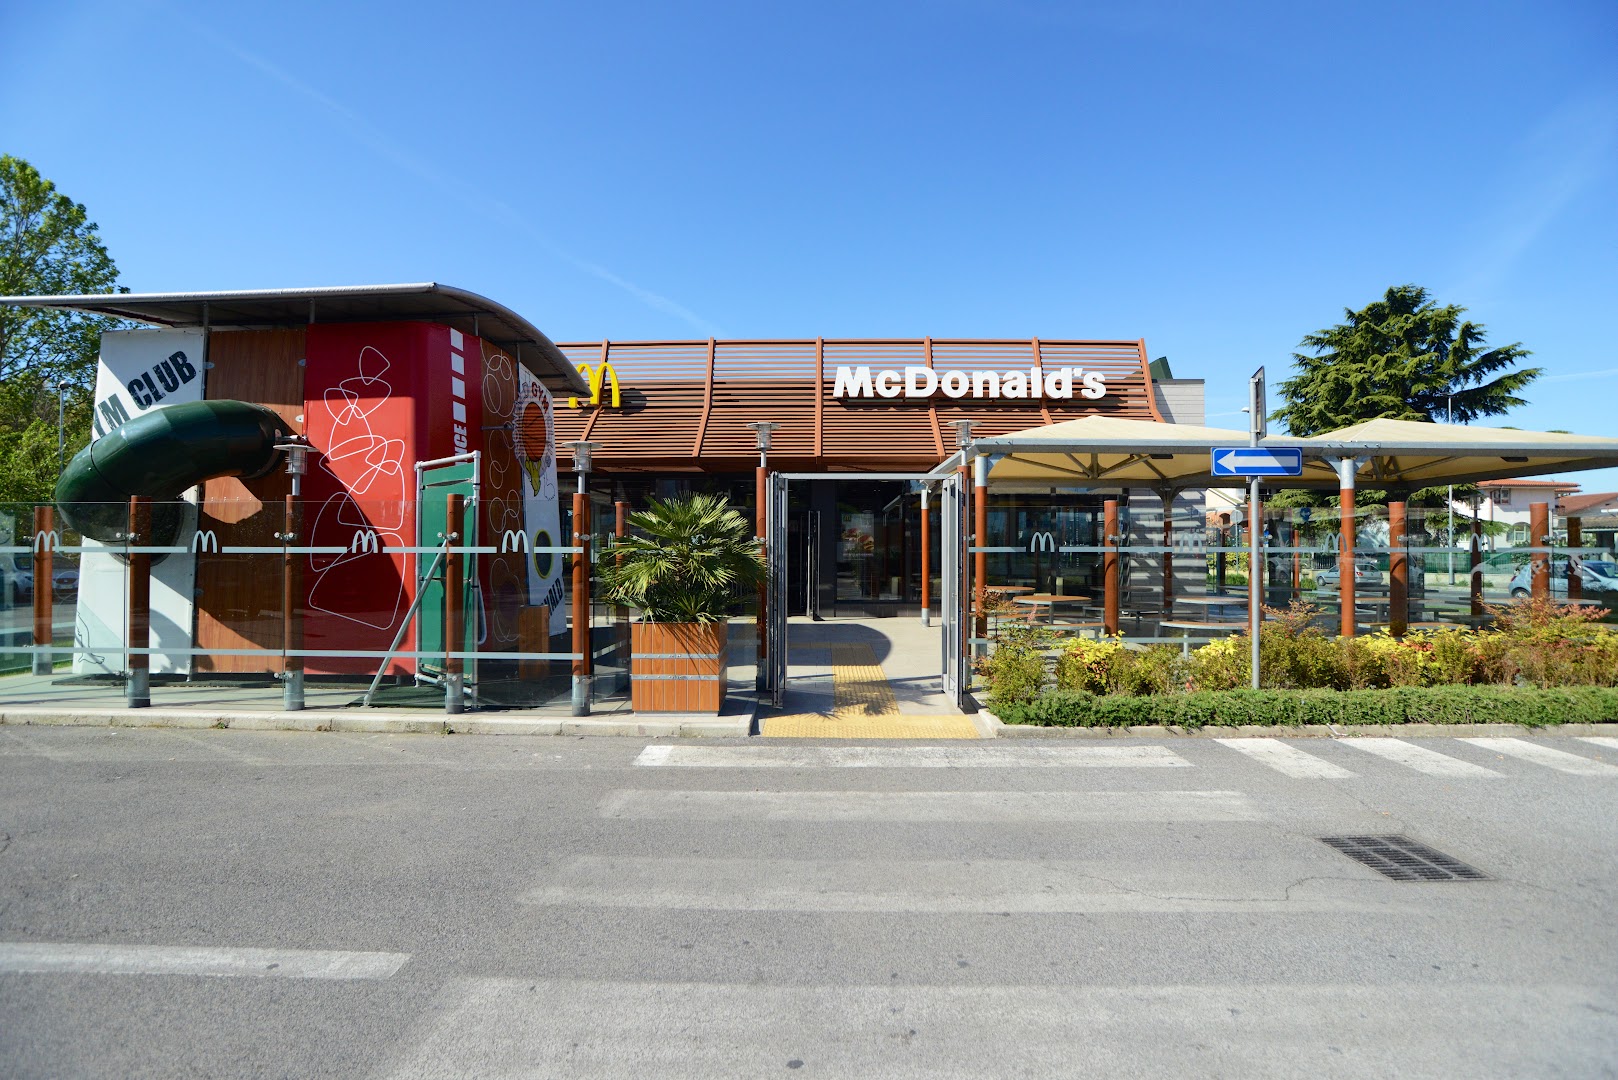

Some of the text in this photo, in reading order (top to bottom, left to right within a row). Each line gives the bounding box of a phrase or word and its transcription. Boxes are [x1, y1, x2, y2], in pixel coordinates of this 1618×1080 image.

[127, 350, 197, 410] CLUB
[833, 366, 1107, 399] McDonald's
[453, 423, 468, 466] NCE
[541, 577, 563, 616] NALD
